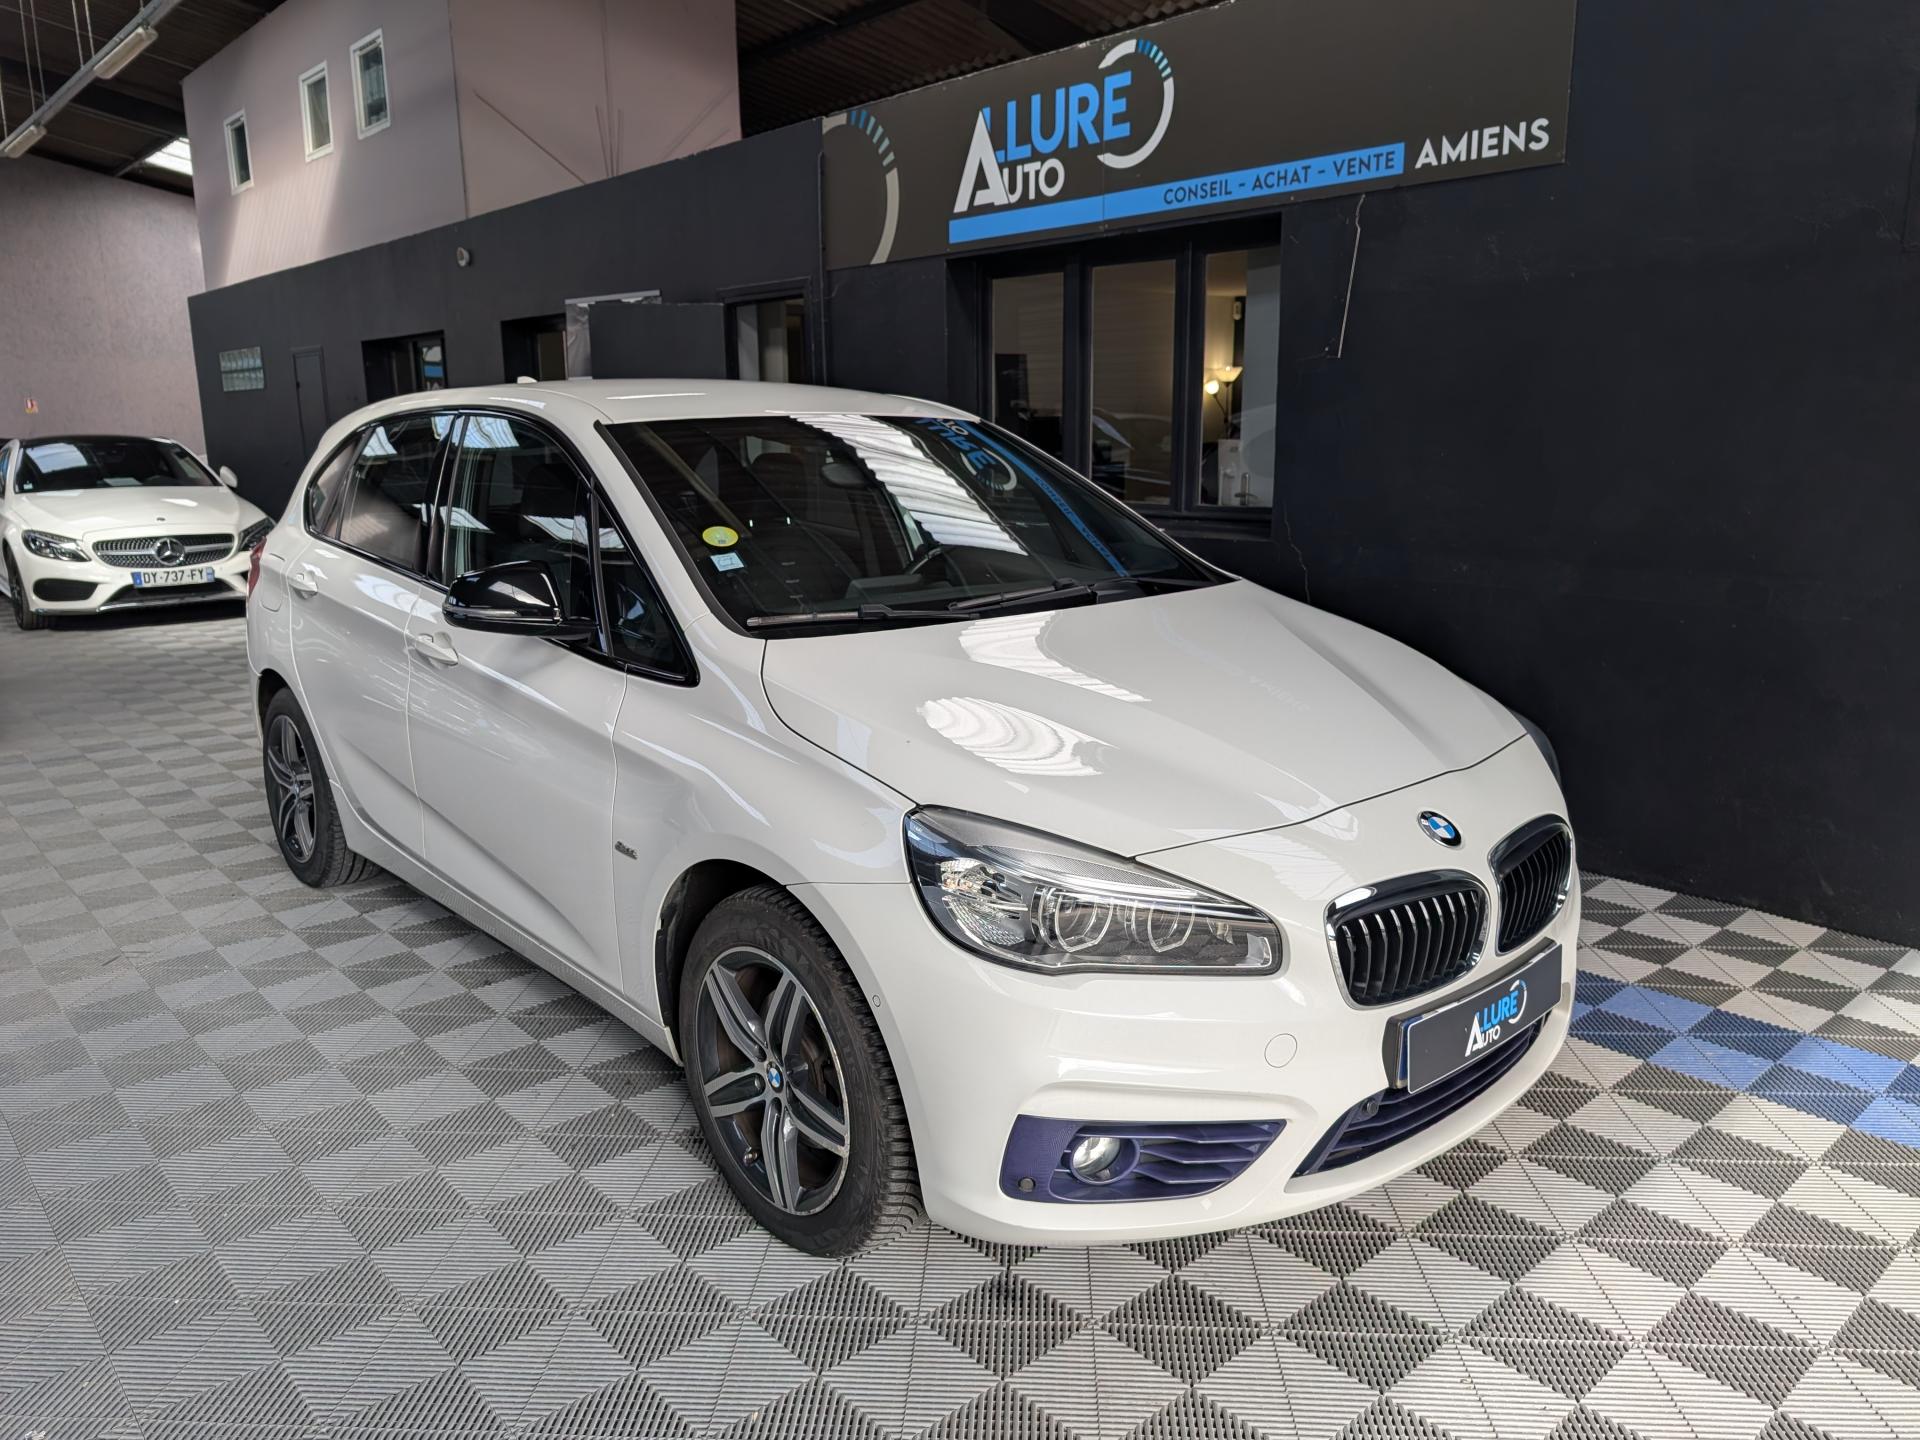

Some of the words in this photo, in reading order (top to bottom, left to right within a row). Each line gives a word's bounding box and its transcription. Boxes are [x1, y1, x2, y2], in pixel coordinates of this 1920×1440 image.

[953, 110, 1065, 213] AUTO
[1415, 118, 1550, 169] AMIENS
[1163, 177, 1232, 205] CONSEIL
[1252, 165, 1311, 192] ACHAT
[1332, 150, 1395, 177] VENTE
